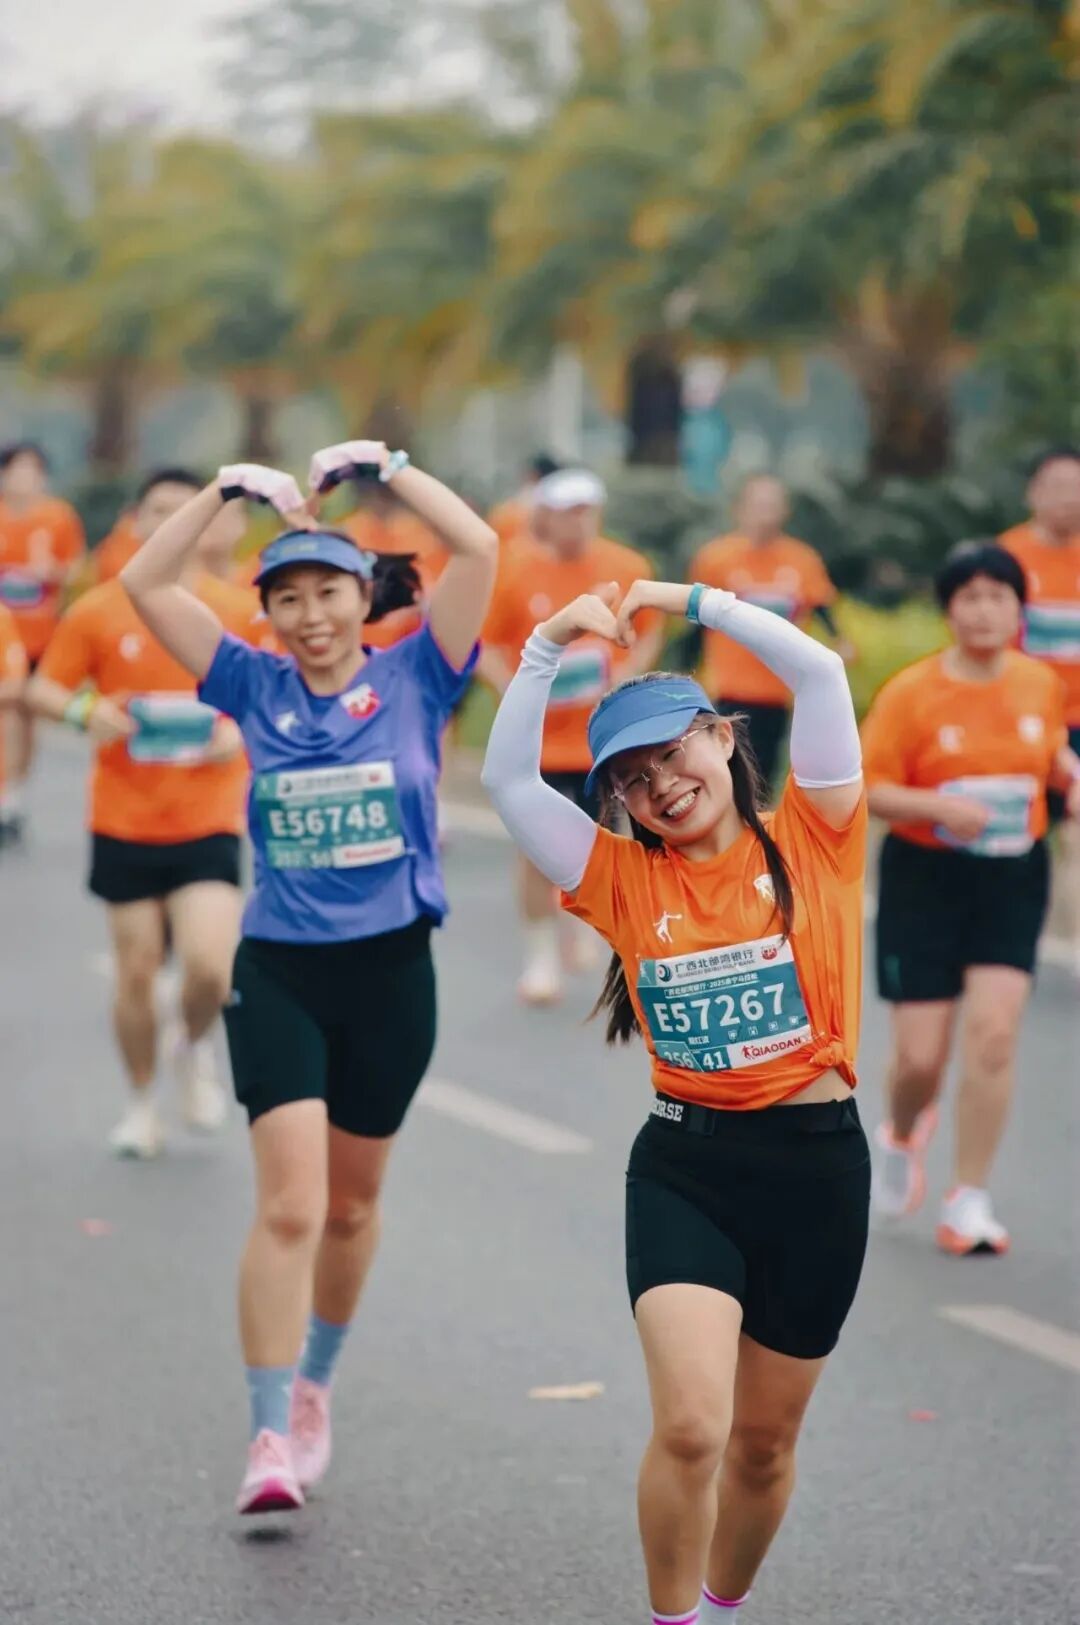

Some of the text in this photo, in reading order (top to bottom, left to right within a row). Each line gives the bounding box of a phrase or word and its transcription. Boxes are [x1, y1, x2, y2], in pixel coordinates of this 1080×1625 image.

[268, 800, 388, 837] E56748
[675, 949, 753, 973] 广西北部湾银行
[652, 982, 785, 1033] E57267
[752, 1036, 802, 1057] QIAODAN
[702, 1051, 727, 1070] 41
